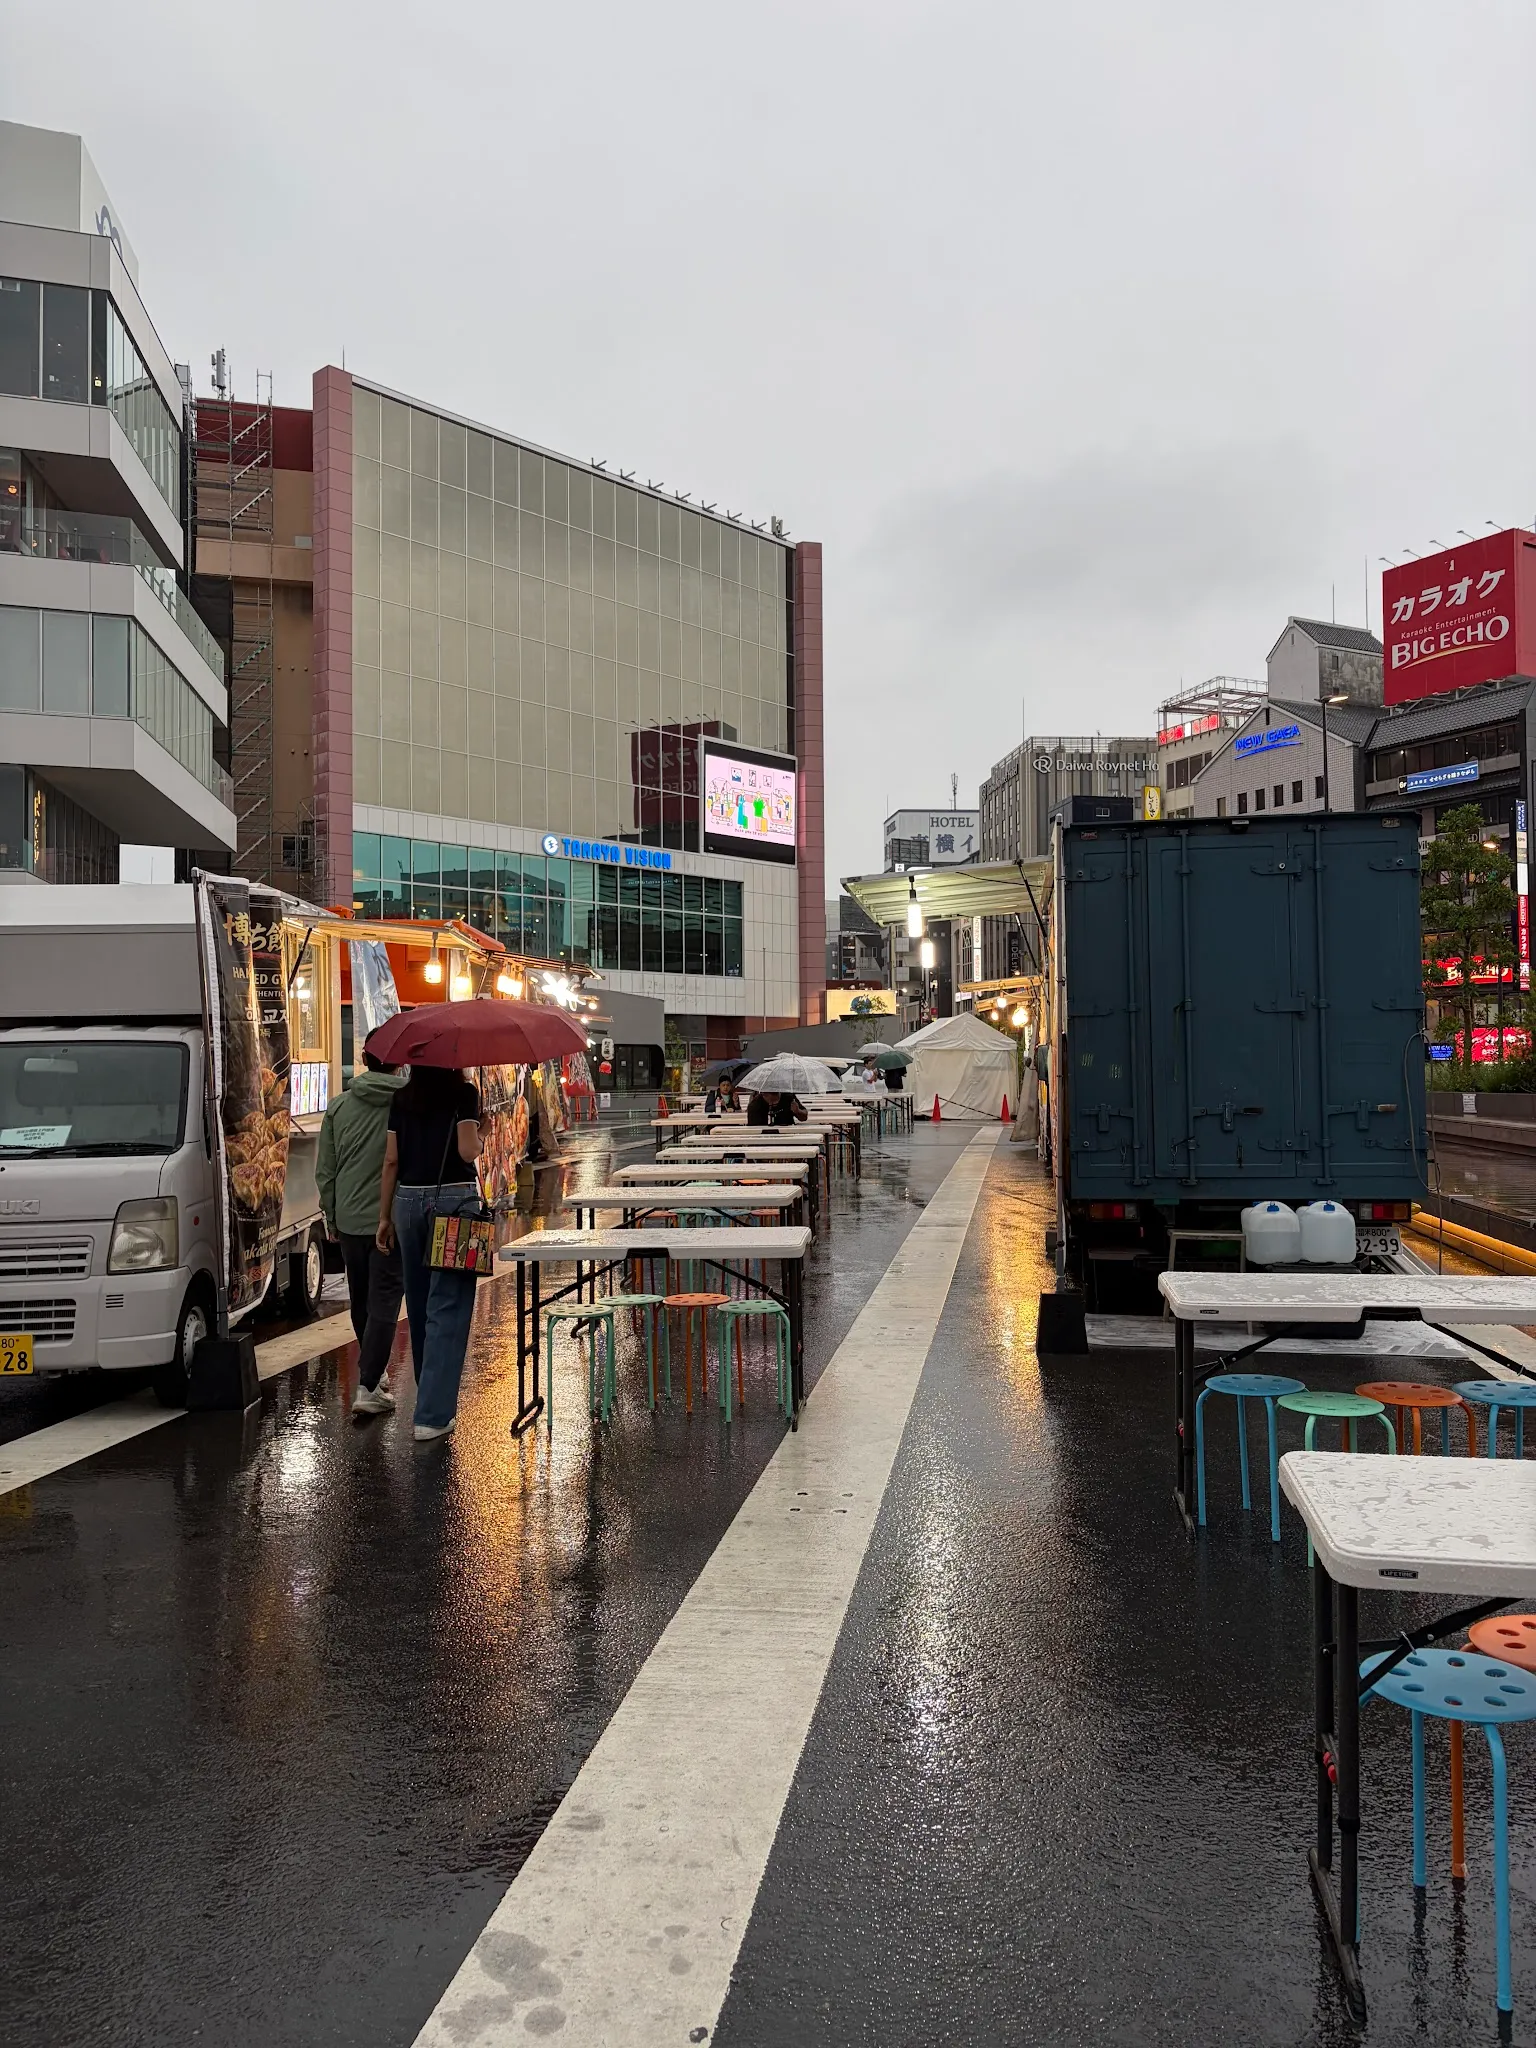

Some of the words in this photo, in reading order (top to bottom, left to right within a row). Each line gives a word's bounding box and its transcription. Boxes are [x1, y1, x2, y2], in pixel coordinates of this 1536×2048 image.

[1390, 569, 1506, 625] カラオケ
[1401, 625, 1433, 640] Karaoke
[1436, 607, 1497, 630] Entertainment
[1391, 637, 1435, 670] BIG
[1440, 615, 1510, 650] ECHO
[1235, 733, 1264, 751] NEW
[1266, 724, 1300, 743] GAEA
[1056, 759, 1094, 772] Daiwa
[1095, 759, 1140, 774] Roynet
[930, 816, 975, 828] HOTEL
[562, 838, 621, 863] TAMAYA
[625, 847, 672, 870] VISION
[1371, 1228, 1387, 1237] 800
[1356, 1238, 1400, 1253] 32-99
[3, 1350, 28, 1372] 28
